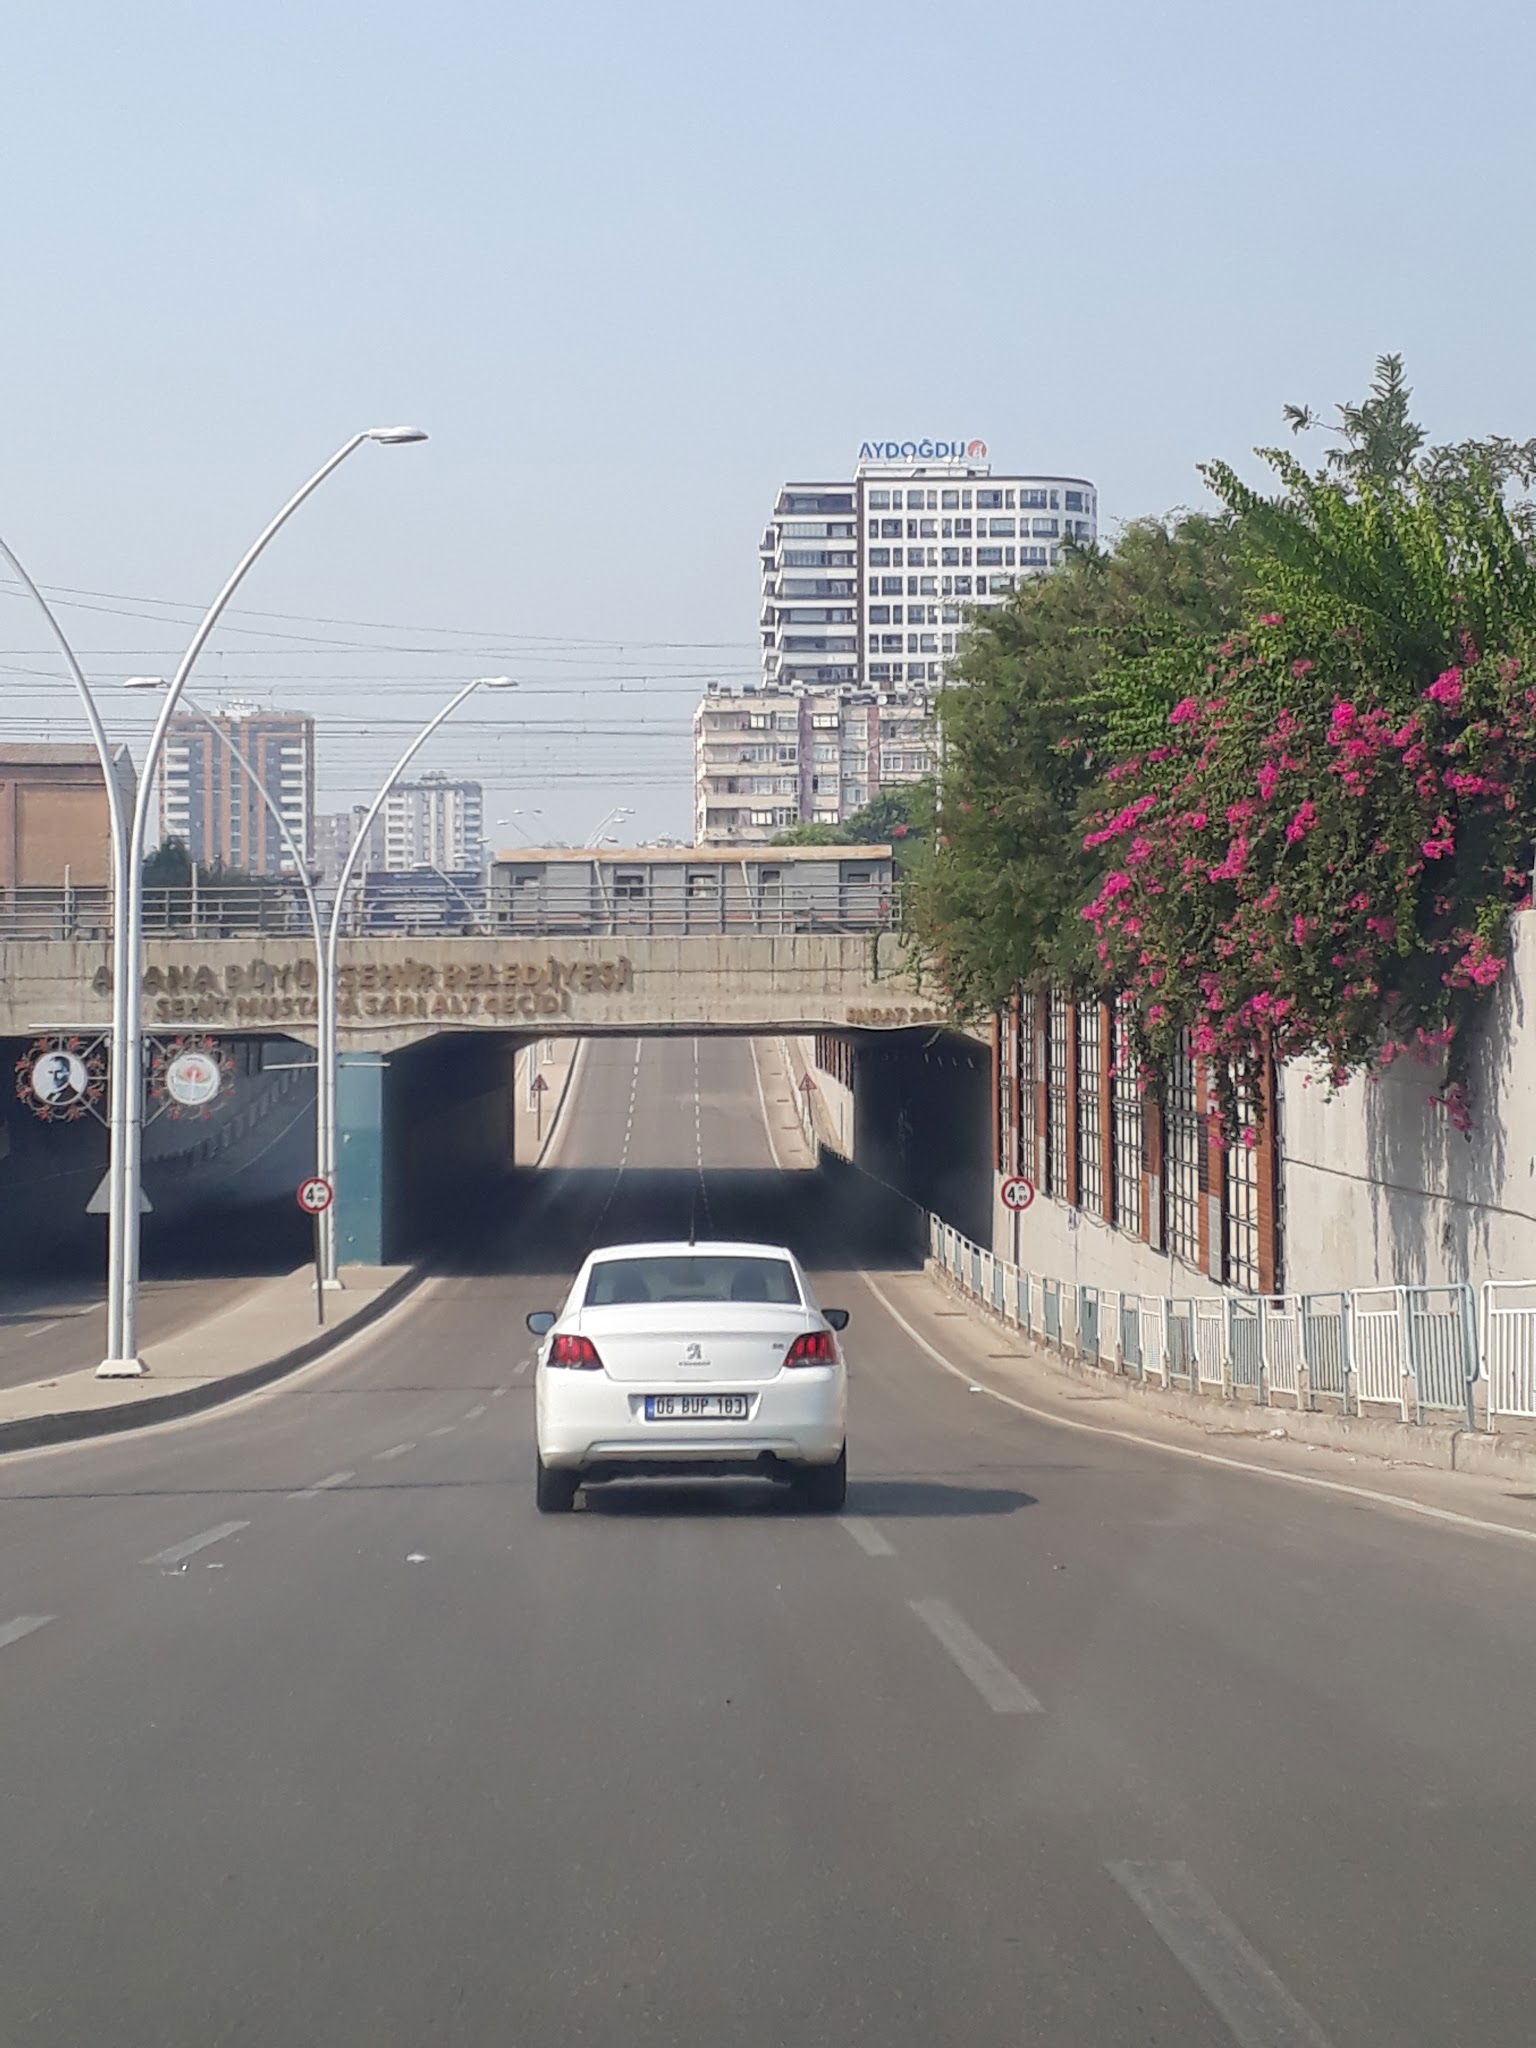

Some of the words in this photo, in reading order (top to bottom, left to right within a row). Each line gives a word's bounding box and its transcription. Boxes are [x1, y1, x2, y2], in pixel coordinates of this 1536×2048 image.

[858, 439, 965, 459] AYDOĞDU
[92, 964, 223, 996] AANA
[225, 957, 437, 995] BÜYÜŞEHİR
[1007, 1186, 1016, 1203] 4
[681, 1397, 709, 1415] BUP
